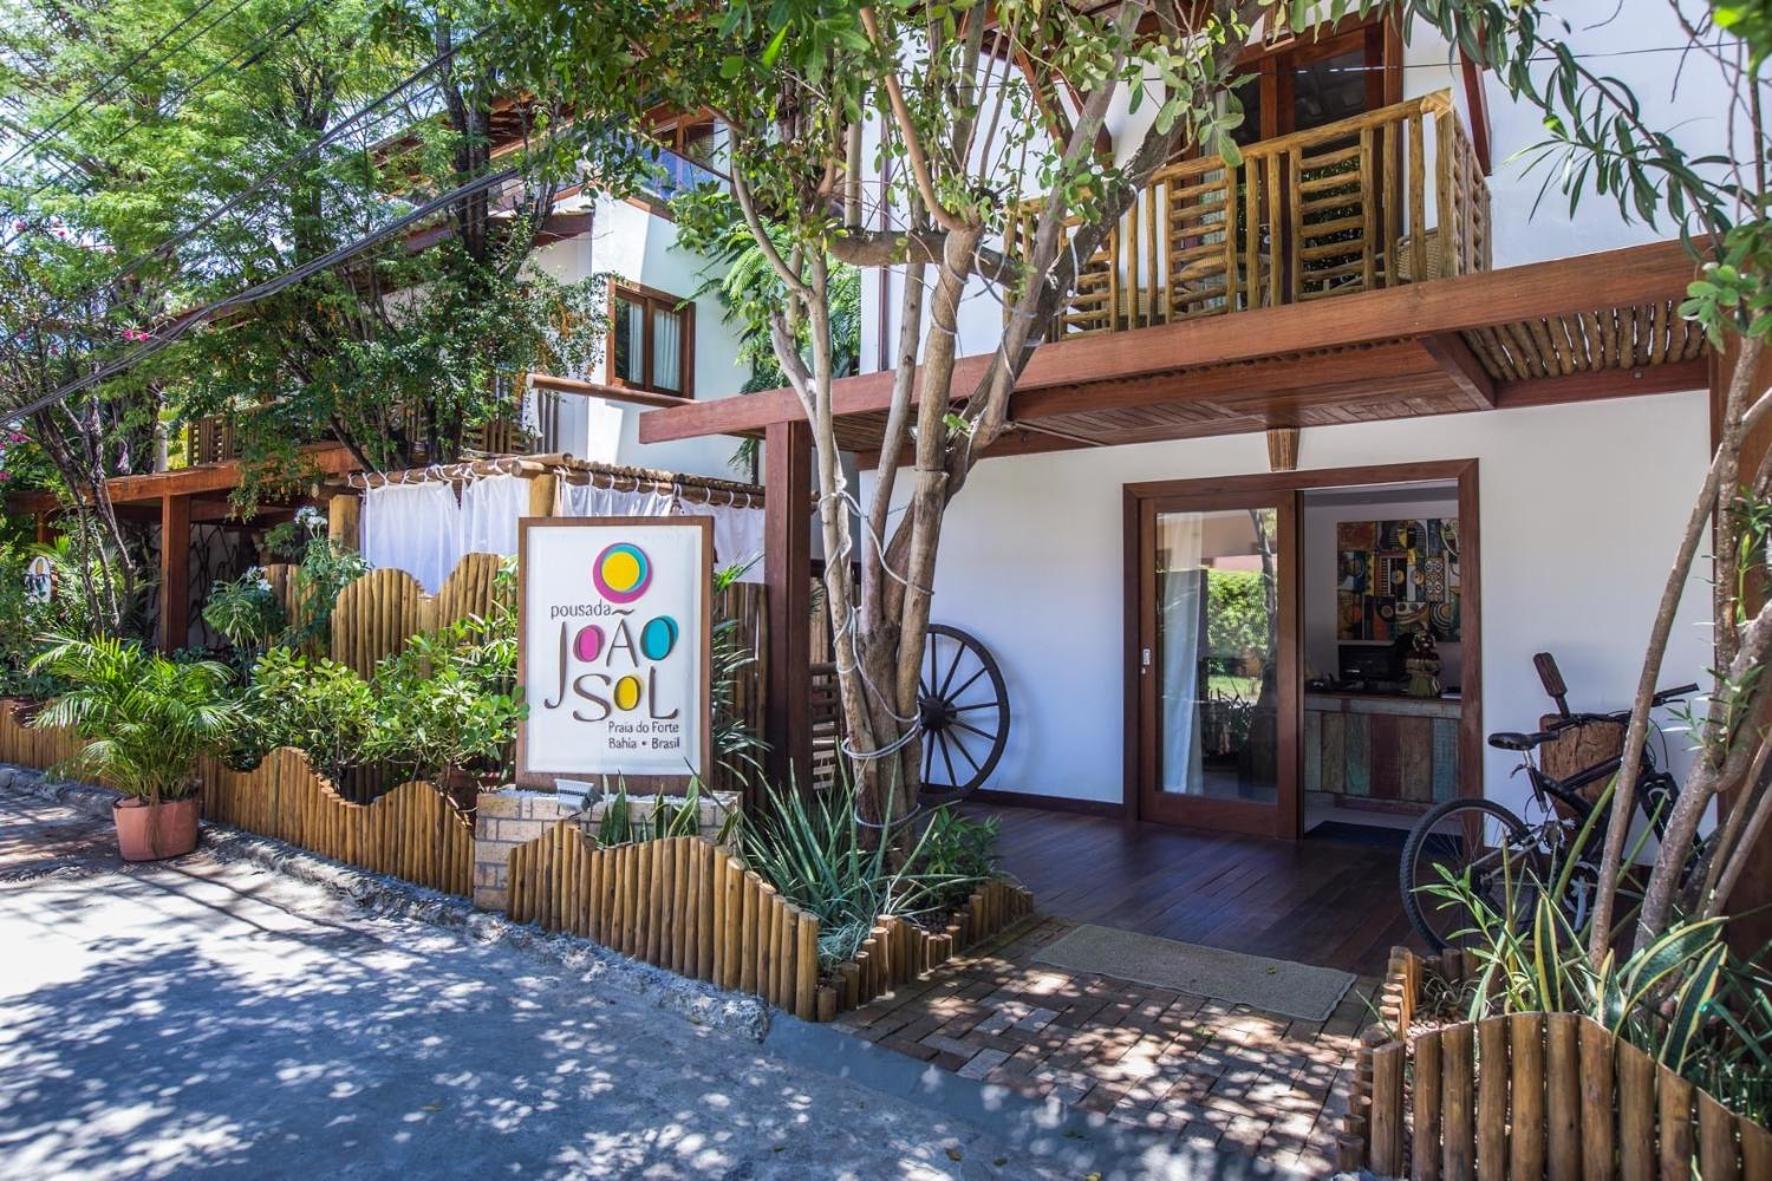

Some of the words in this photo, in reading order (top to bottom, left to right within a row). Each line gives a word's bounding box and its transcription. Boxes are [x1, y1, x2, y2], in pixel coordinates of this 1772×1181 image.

[551, 599, 611, 619] pousada
[608, 721, 634, 733] Praia
[636, 721, 649, 733] do
[652, 720, 679, 733] Forte
[608, 737, 637, 749] Bahia
[651, 737, 680, 749] Brasil
